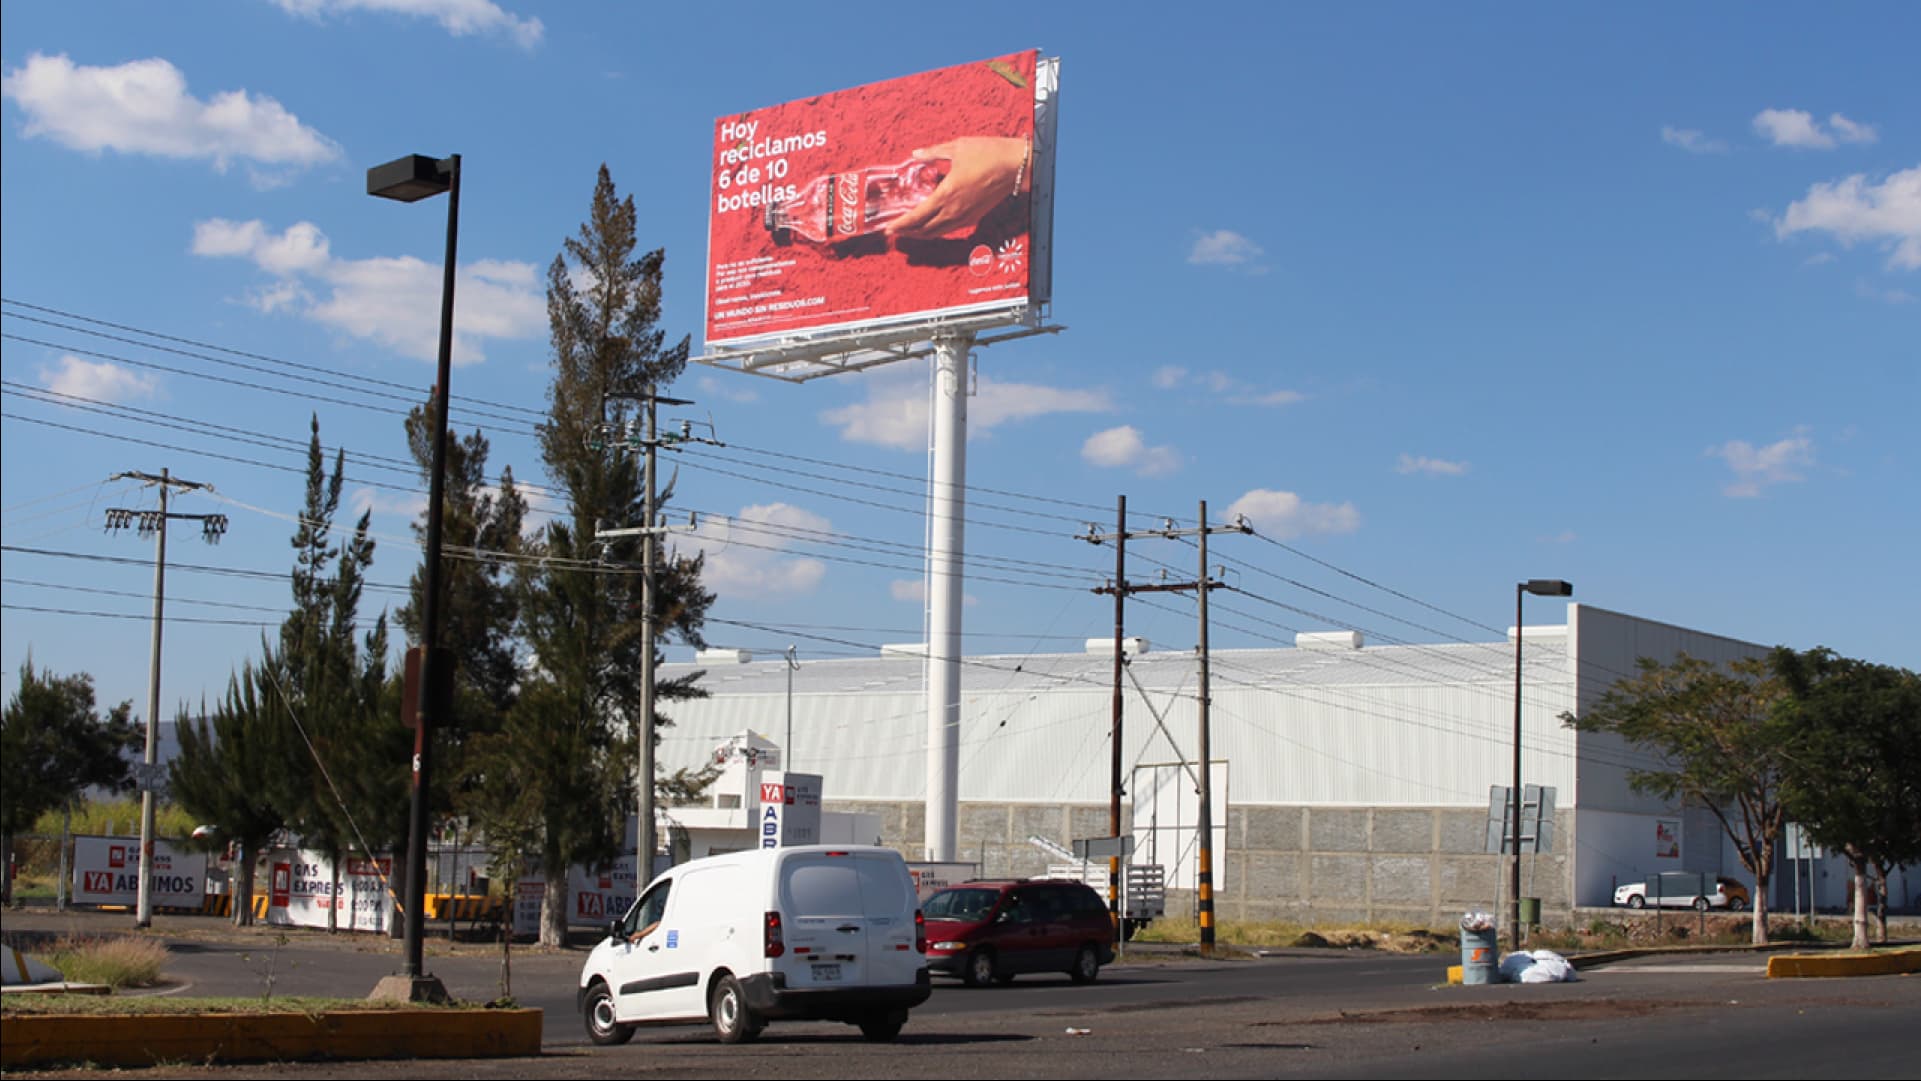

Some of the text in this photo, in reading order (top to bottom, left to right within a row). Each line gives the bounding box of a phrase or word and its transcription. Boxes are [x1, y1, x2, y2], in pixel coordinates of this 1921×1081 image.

[721, 120, 759, 142] Hoy
[720, 130, 827, 166] reciclamos
[719, 158, 788, 189] 6 de 10
[763, 785, 781, 801] YA
[294, 863, 319, 877] GAS
[88, 872, 194, 893] YA ABIMOS
[294, 880, 344, 896] EXPRES
[581, 893, 602, 914] YA
